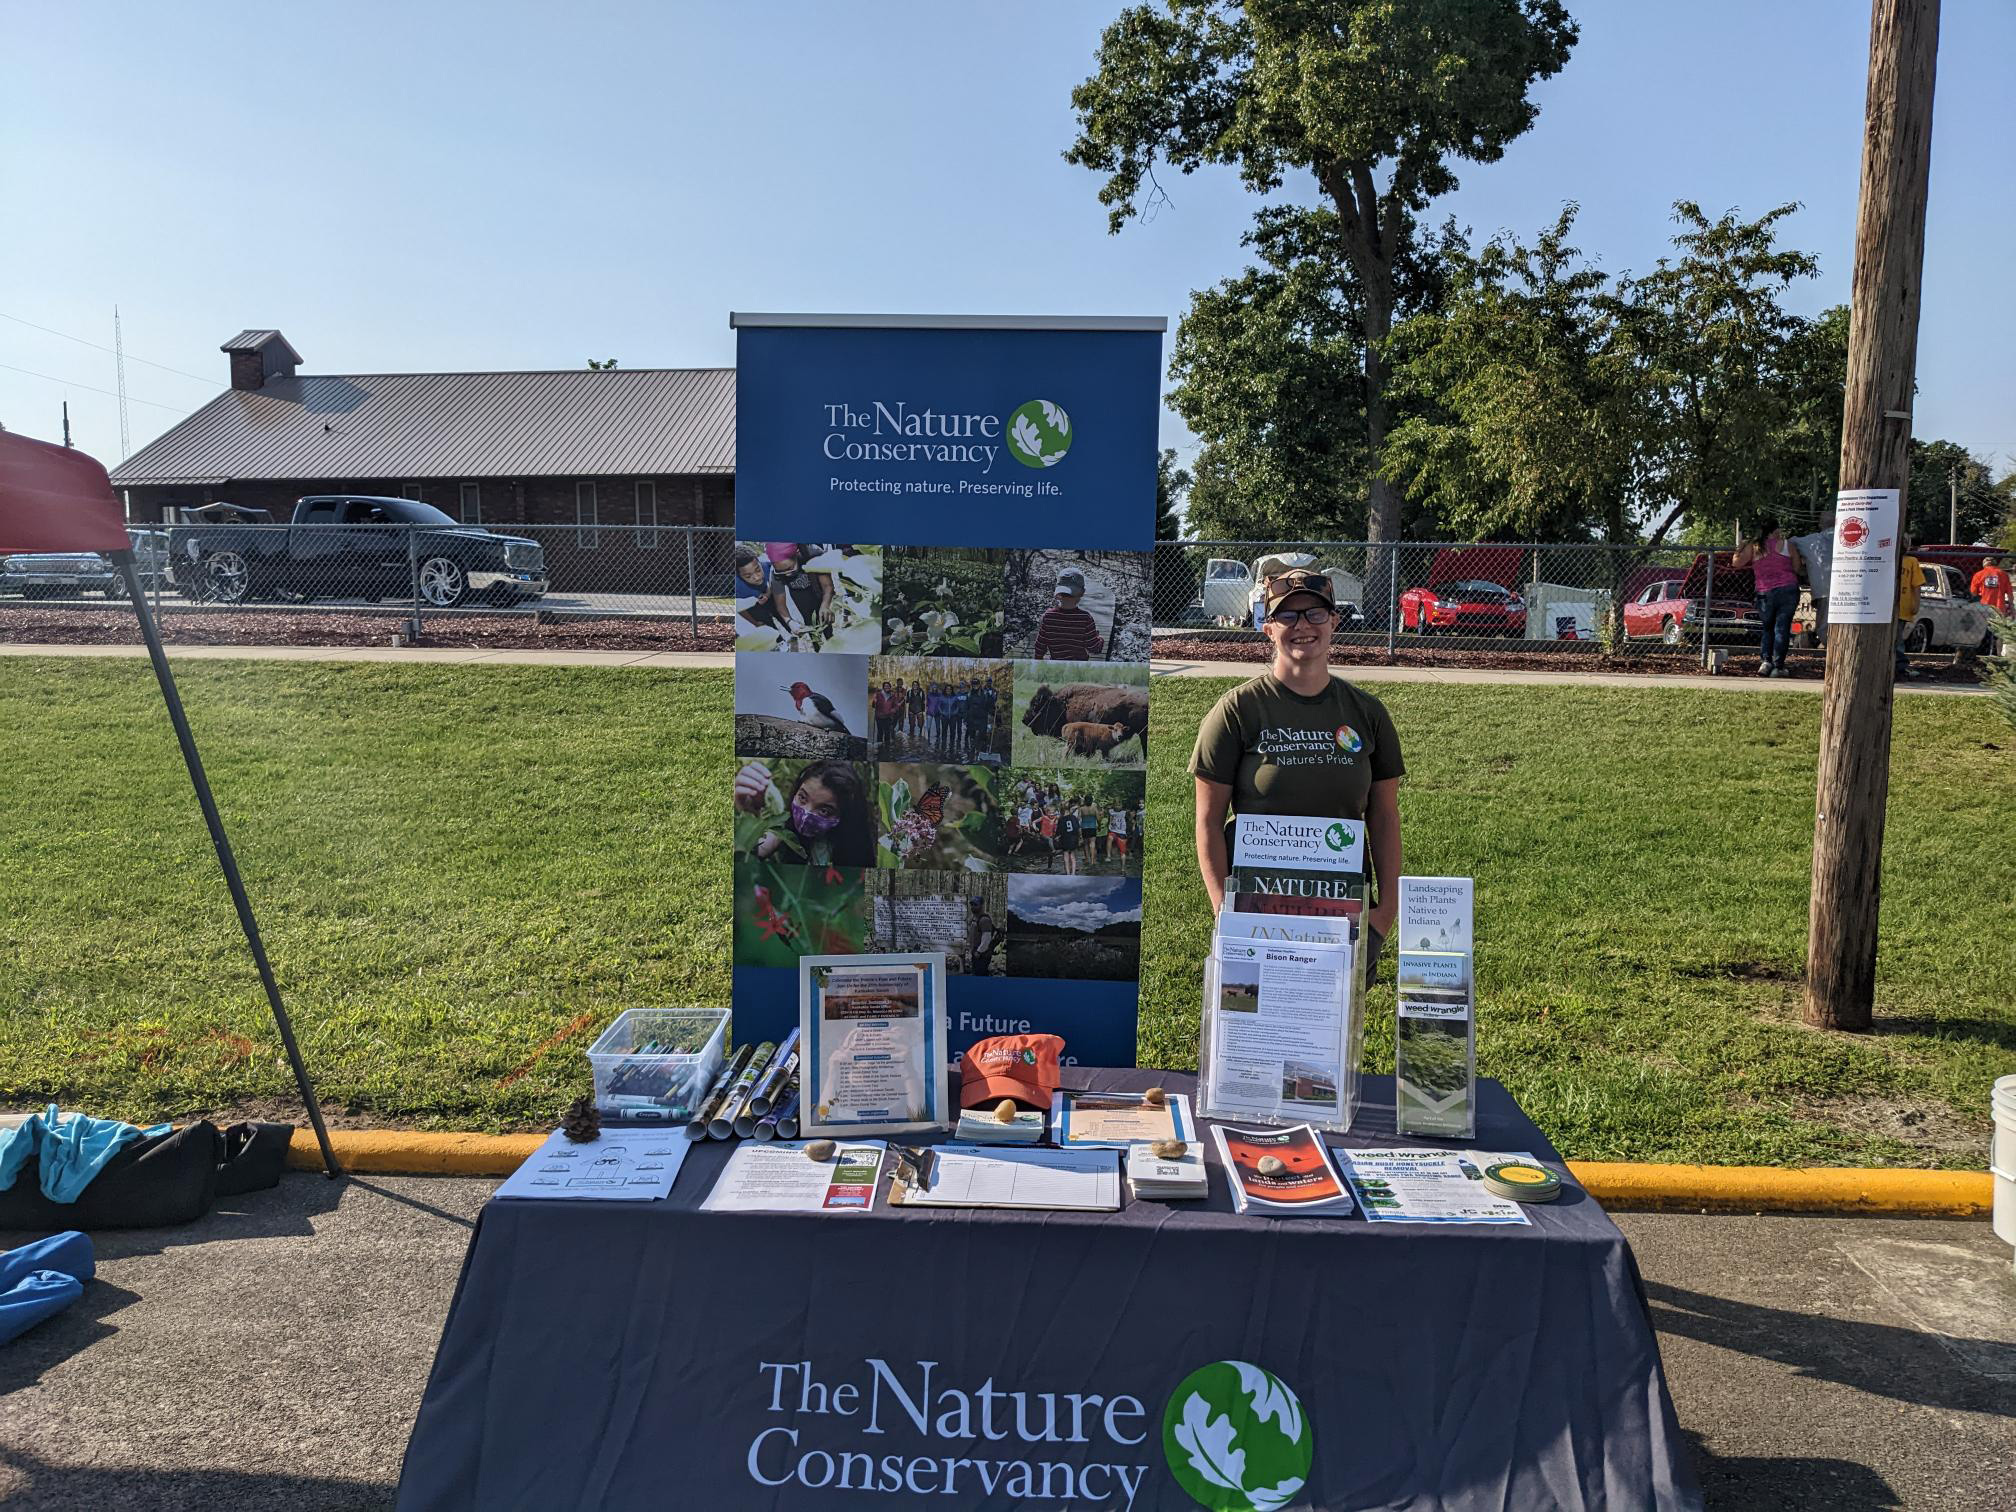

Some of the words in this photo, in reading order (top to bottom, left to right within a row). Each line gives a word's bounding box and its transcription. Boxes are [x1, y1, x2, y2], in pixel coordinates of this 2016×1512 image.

[824, 403, 871, 428] The
[872, 401, 1000, 438] Nature
[823, 433, 999, 474] Conservancy
[830, 477, 902, 495] Protecting
[905, 481, 955, 494] nature.
[959, 481, 1033, 498] Preserving
[1037, 481, 1062, 496] life.
[1259, 729, 1278, 741] The
[1277, 727, 1334, 743] Nature
[1257, 741, 1336, 755] Conservancy
[1276, 754, 1324, 766] Nature's
[1326, 755, 1354, 765] Pride
[1066, 820, 1073, 832] 9
[1243, 821, 1264, 832] The
[1265, 820, 1323, 838] Nature
[1242, 833, 1322, 854] Conservancy
[1244, 852, 1277, 862] Protecting
[1278, 854, 1301, 862] nature.
[1302, 855, 1337, 865] Preserving
[1254, 876, 1347, 899] NATURE
[1408, 884, 1464, 895] Landscaping
[1408, 896, 1428, 904] with
[1430, 896, 1457, 904] Plants
[1408, 906, 1437, 915] Native
[1439, 907, 1448, 915] to
[1408, 917, 1441, 926] Indiana
[1266, 953, 1288, 961] Bison
[1290, 954, 1317, 964] Ranger
[1405, 1004, 1429, 1013] weed
[1430, 1004, 1465, 1015] wrangle
[960, 1011, 1031, 1034] Future
[992, 1049, 1022, 1057] Nature
[1398, 1151, 1458, 1159] wrangle
[1248, 1176, 1277, 1186] lands
[1287, 1176, 1323, 1186] waters
[759, 1361, 860, 1415] The
[862, 1358, 1147, 1445] Nature
[747, 1427, 1149, 1512] Conservancy
